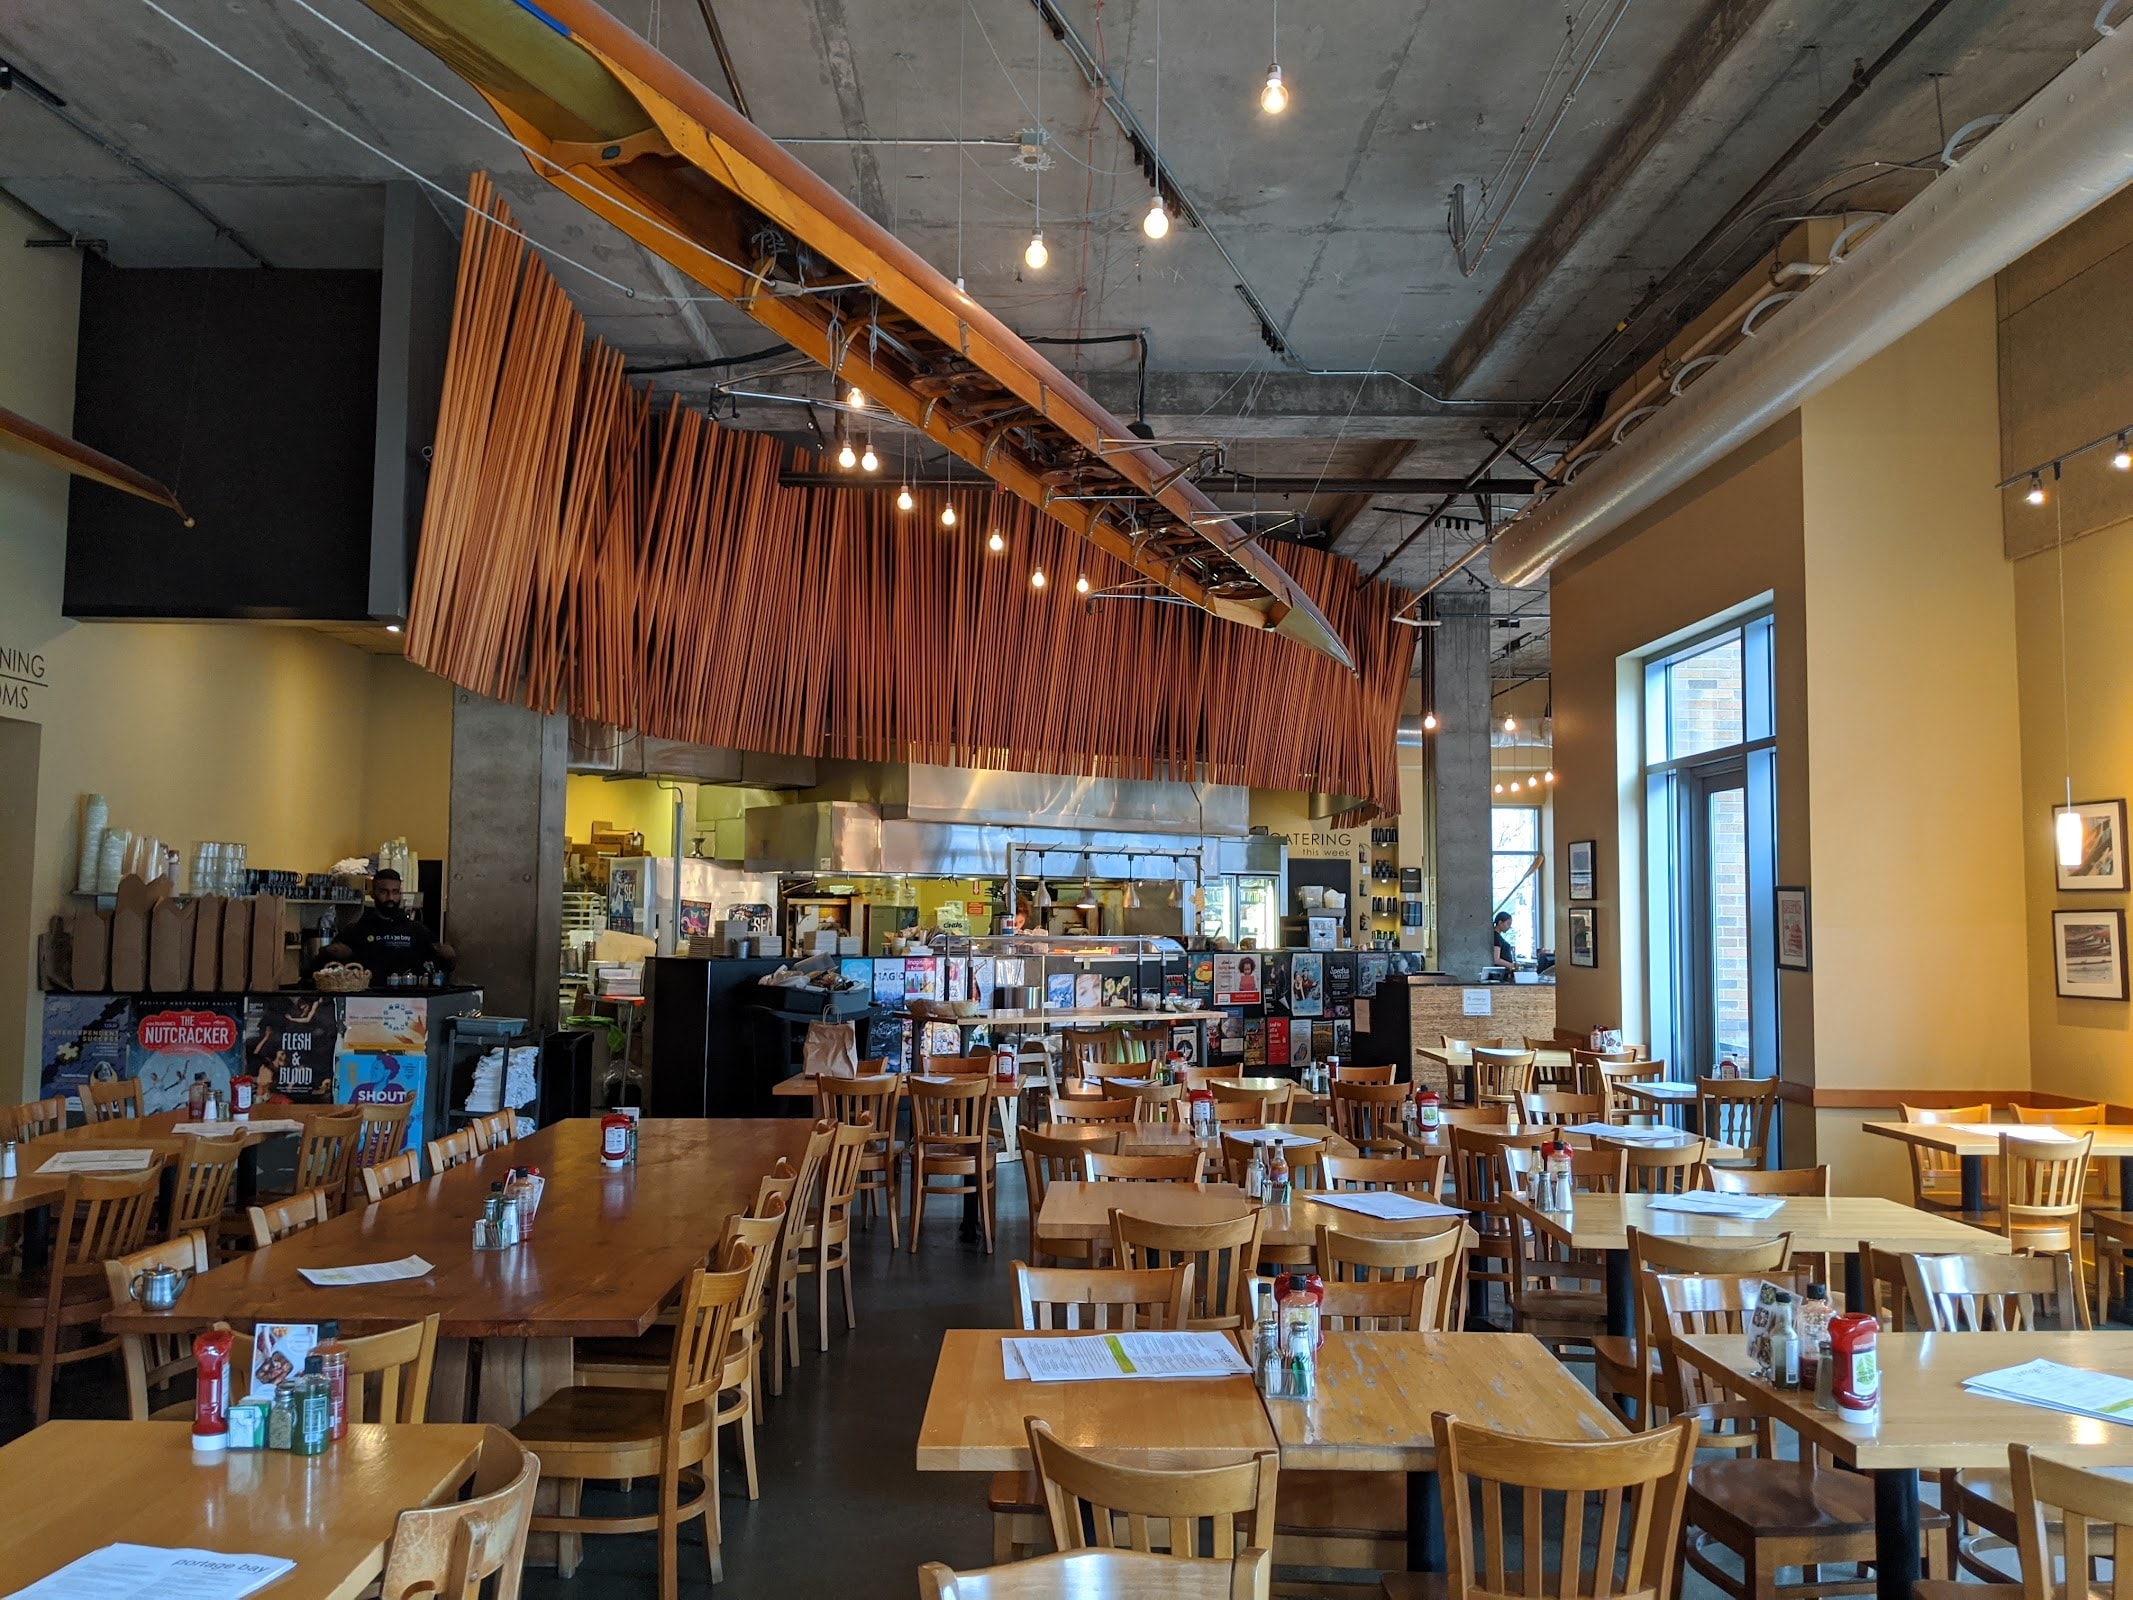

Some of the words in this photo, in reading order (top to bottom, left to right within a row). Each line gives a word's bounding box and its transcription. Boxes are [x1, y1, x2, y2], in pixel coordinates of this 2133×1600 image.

[0, 684, 28, 709] MS
[1270, 833, 1351, 846] ATERING
[1303, 848, 1319, 856] this
[1324, 848, 1350, 856] week
[180, 1015, 195, 1026] THE
[144, 1026, 229, 1044] NUTCRACKER
[282, 1032, 311, 1051] FLESH
[291, 1051, 301, 1066] &
[279, 1067, 312, 1085] BLOOD
[358, 1090, 407, 1102] SHOUT
[171, 1559, 235, 1569] portage
[238, 1563, 269, 1574] bay
